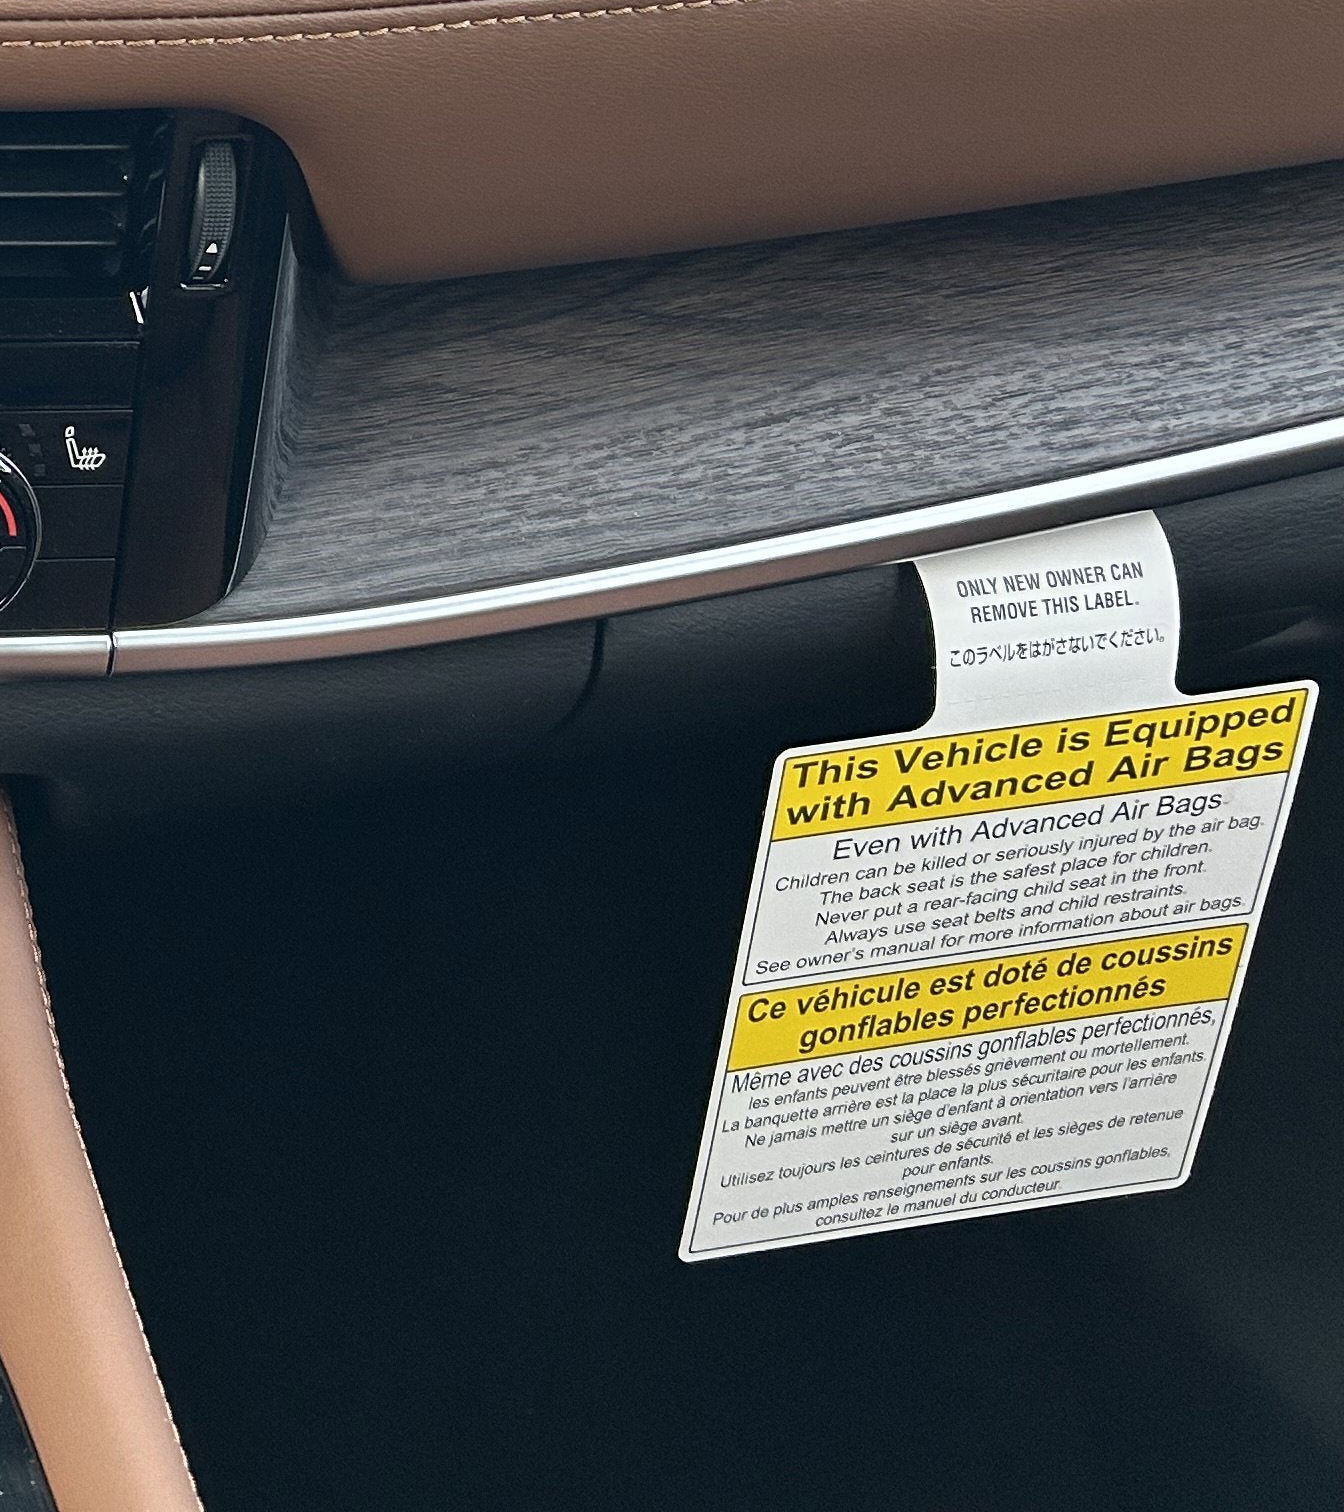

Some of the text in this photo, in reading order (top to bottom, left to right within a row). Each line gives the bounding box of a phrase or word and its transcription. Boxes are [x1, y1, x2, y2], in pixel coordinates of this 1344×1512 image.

[957, 562, 1144, 598] ONLY NEW OWNER CAN
[970, 592, 1140, 624] REMOVE THIS LABEL.
[793, 699, 1297, 789] This Vehicle is Equipped
[787, 742, 1285, 826] with Advanced Air Bags
[776, 872, 853, 892] Children
[855, 866, 888, 881] can
[892, 859, 919, 877] be
[920, 853, 969, 875] killed
[971, 852, 992, 866] or
[995, 841, 1076, 863] seriously
[1078, 832, 1138, 853] injured
[1142, 829, 1165, 844] by
[1168, 822, 1197, 838] the
[1198, 822, 1222, 834] air
[833, 837, 901, 861] Even
[911, 824, 963, 850] with
[970, 805, 1106, 843] Advanced
[1109, 801, 1151, 824] Air
[815, 909, 871, 927] Never
[873, 902, 903, 920] put
[907, 903, 919, 914] a
[923, 888, 1019, 912] rear-facing
[1023, 879, 1066, 898] child
[1068, 874, 1108, 892] seat
[1110, 872, 1127, 886] in
[1130, 869, 1159, 883] the
[820, 891, 854, 906] The
[858, 882, 902, 901] back
[906, 876, 946, 894] seat
[949, 874, 966, 889] is
[969, 871, 999, 886] the
[1002, 861, 1057, 881] safest
[1058, 857, 1108, 876] place
[1112, 852, 1138, 866] for
[756, 960, 792, 975] See
[796, 948, 865, 969] owner's
[870, 937, 936, 959] manual
[939, 935, 966, 949] for
[969, 928, 1014, 945] more
[1018, 914, 1117, 938] information
[1119, 906, 1170, 925] about
[1172, 902, 1195, 916] air
[825, 926, 889, 945] Always
[894, 921, 928, 936] use
[931, 912, 970, 931] seat
[973, 907, 1016, 925] belts
[1020, 900, 1055, 918] and
[1058, 894, 1100, 914] child
[748, 937, 1234, 1024] Ce véhicule est doté de coussins
[798, 978, 1167, 1054] gonflables perfectionnés
[732, 1071, 792, 1092] Même
[797, 1060, 845, 1084] avec
[849, 1056, 884, 1076] des
[888, 1042, 973, 1070] coussins
[977, 1026, 1077, 1061] gonflables
